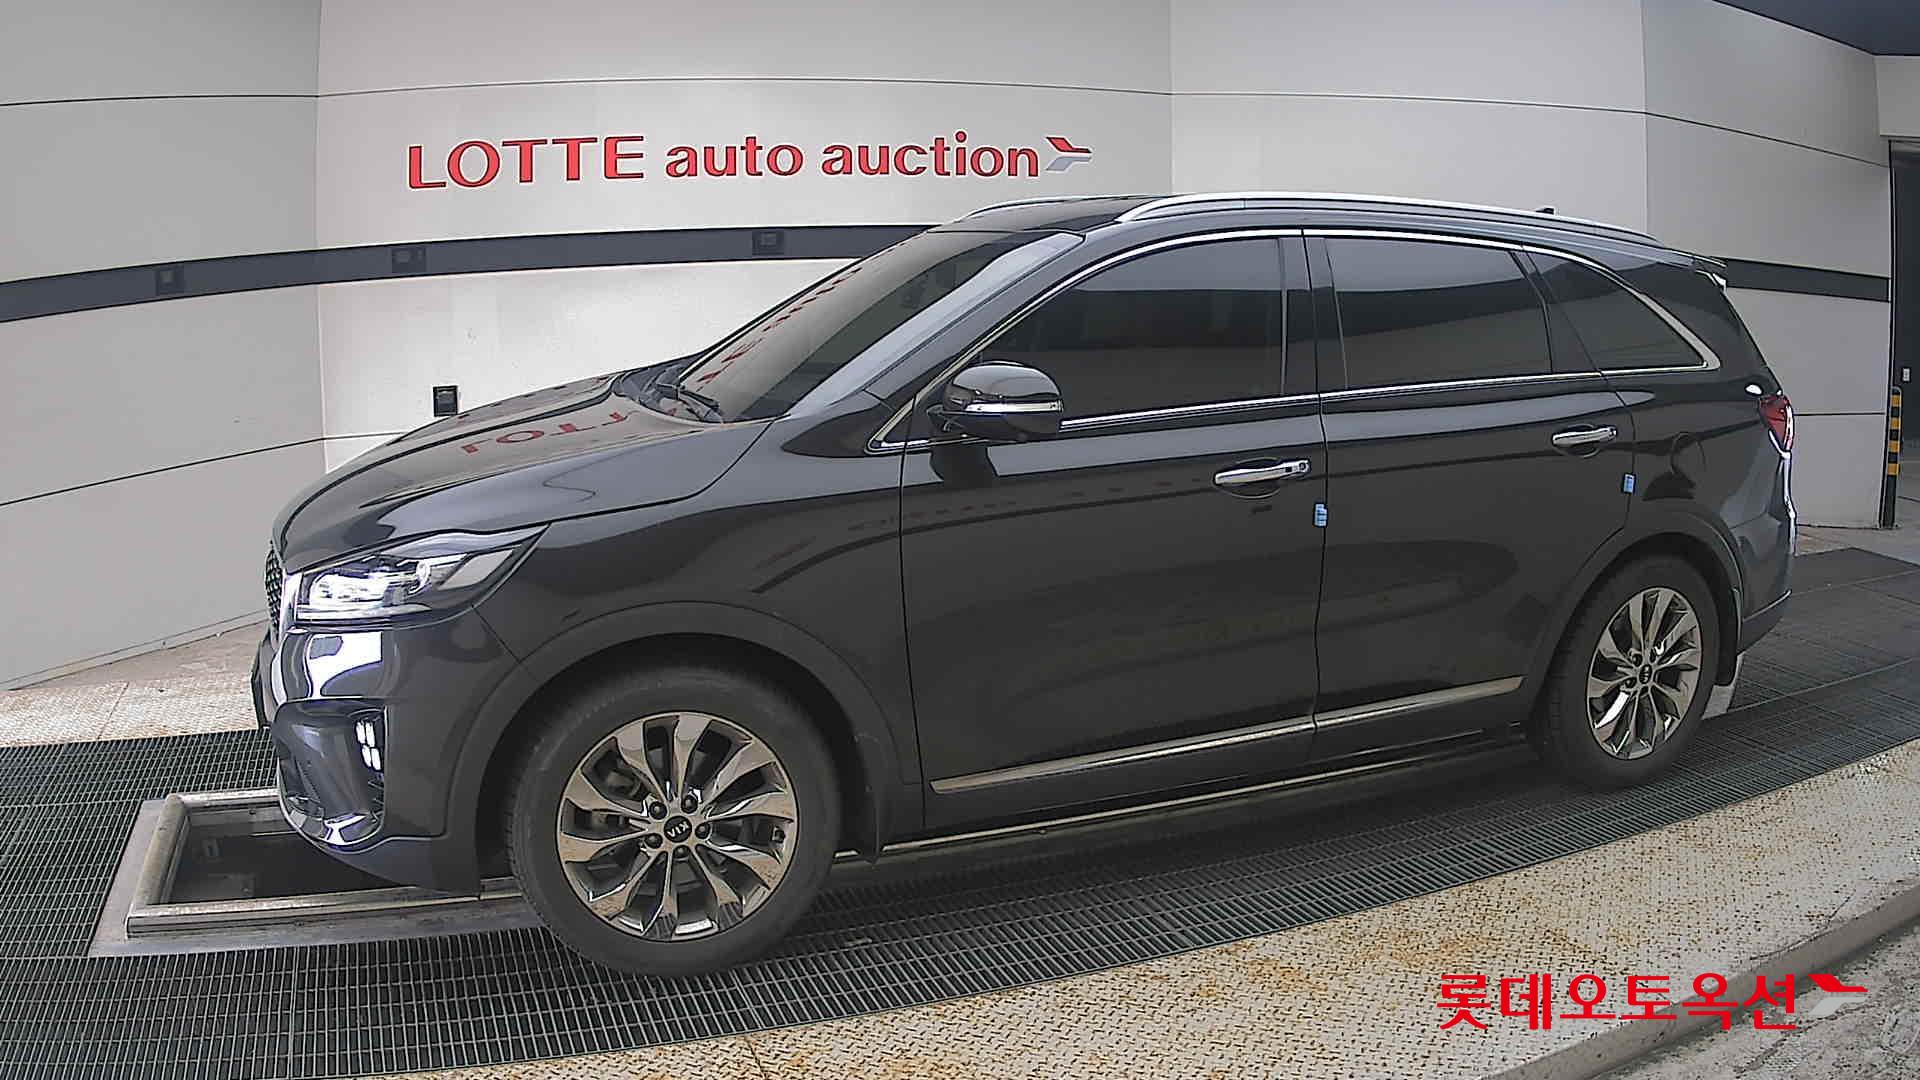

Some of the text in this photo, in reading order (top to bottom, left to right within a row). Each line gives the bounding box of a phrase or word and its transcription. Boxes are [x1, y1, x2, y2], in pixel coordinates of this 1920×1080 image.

[407, 130, 1041, 190] LOTTE auto auction
